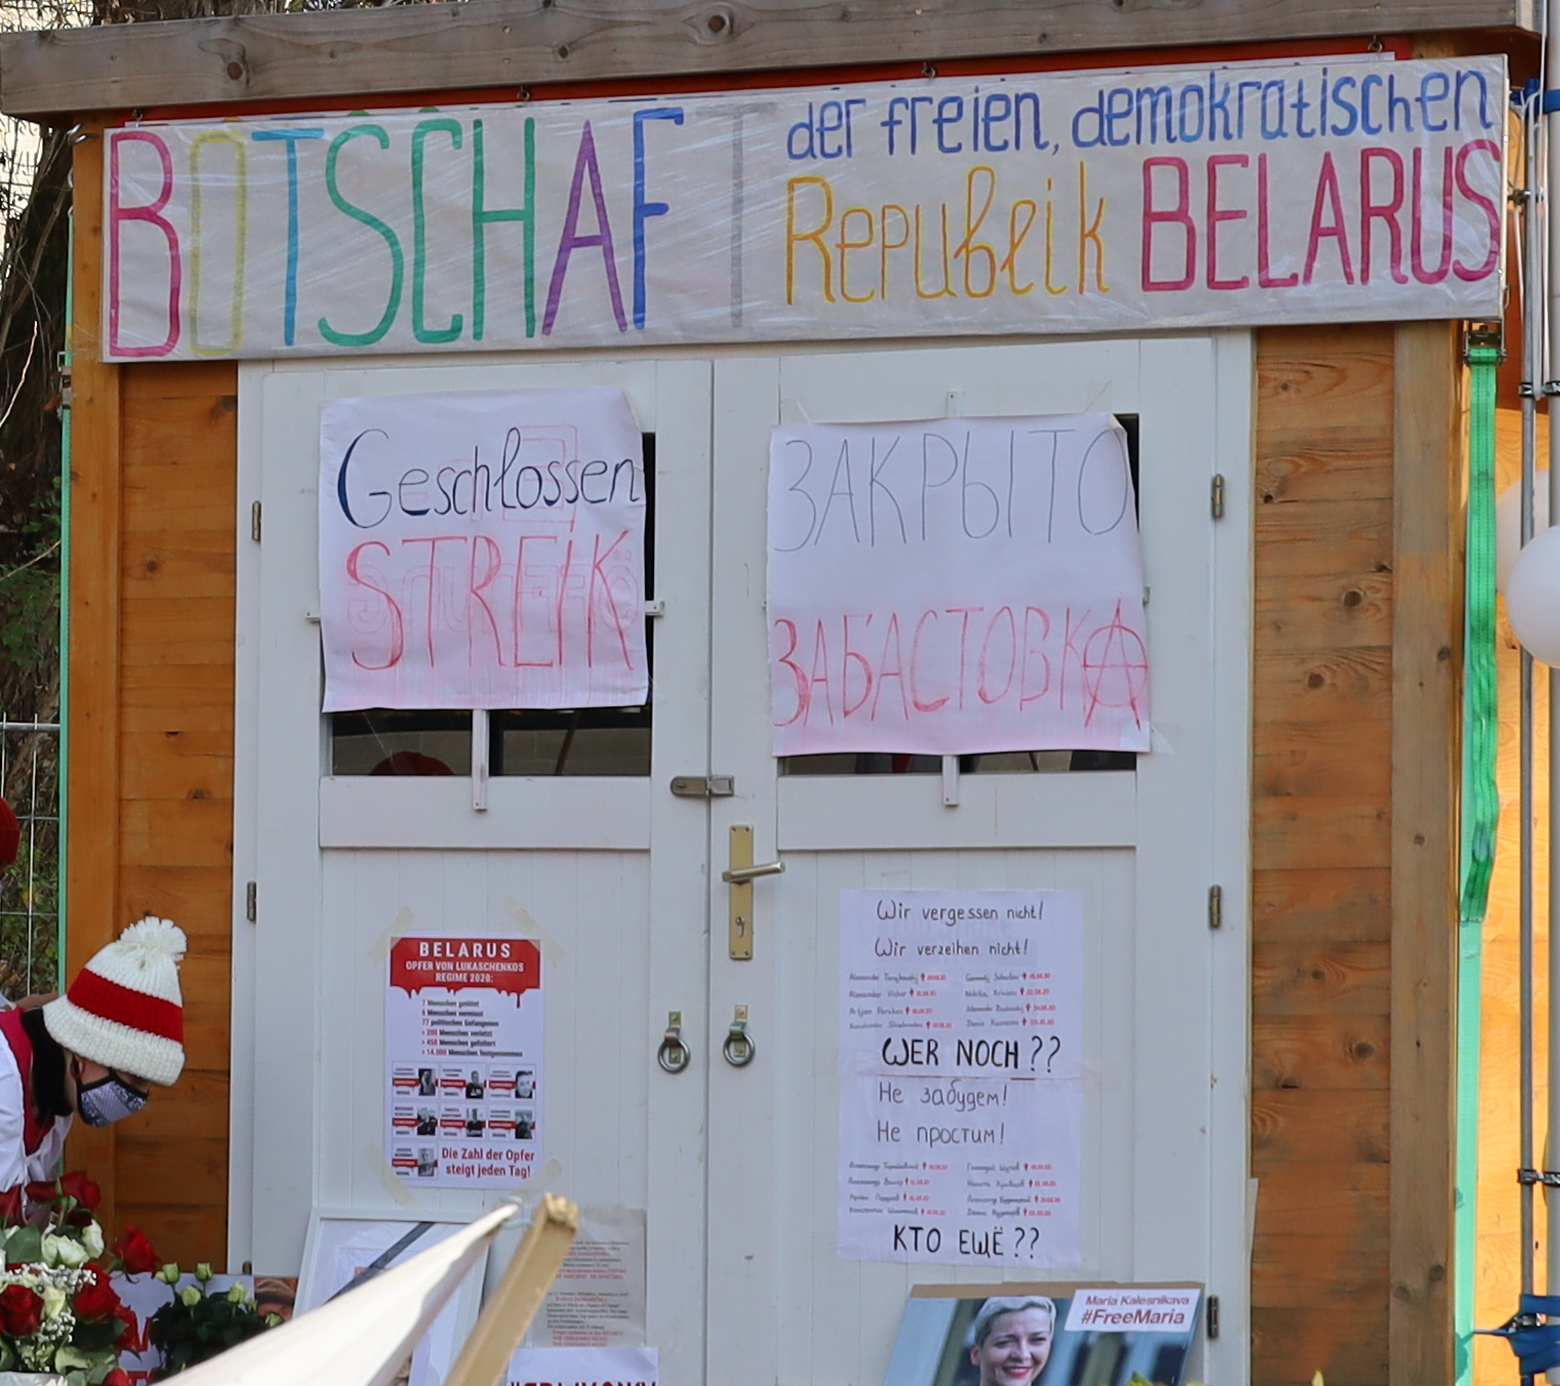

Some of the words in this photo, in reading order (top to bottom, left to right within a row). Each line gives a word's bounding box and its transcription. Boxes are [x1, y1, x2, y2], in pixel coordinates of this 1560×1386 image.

[787, 98, 866, 161] der
[880, 83, 1061, 159] freien,
[1073, 66, 1494, 150] demokratischen
[785, 159, 1111, 306] Republik
[1140, 138, 1503, 294] BELARUS
[337, 426, 640, 529] Geschlossen
[774, 428, 1129, 553] ЗАКРЫТО
[773, 597, 1149, 730] ЗАБАСТОВКА
[876, 899, 911, 921] Wir
[922, 905, 999, 927] vergessen
[1006, 900, 1044, 921] nicht!
[419, 941, 511, 958] BELARUS
[874, 938, 907, 958] Wir
[916, 939, 979, 957] verzeihen
[988, 937, 1029, 957] nicht!
[406, 961, 433, 971] OPFER
[435, 961, 454, 971] VON
[455, 961, 524, 973] LUKASCHENKOS
[435, 973, 468, 983] REGIME
[469, 973, 494, 983] 2020:
[881, 1036, 939, 1067] WER
[879, 1081, 904, 1104] Не
[920, 1078, 1008, 1113] забудем!
[877, 1119, 901, 1143] Не
[916, 1122, 1006, 1148] простим!
[442, 1147, 458, 1159] Die
[461, 1148, 483, 1160] Zahl
[485, 1148, 503, 1161] der
[505, 1149, 535, 1163] Opfer
[446, 1163, 475, 1178] steigt
[477, 1163, 506, 1178] jeden
[508, 1164, 531, 1179] Tag!
[893, 1224, 942, 1253] КТО
[1085, 1295, 1118, 1306] Maria
[1120, 1295, 1190, 1306] Kalesnikava
[1081, 1308, 1185, 1325] #FreeMaria
